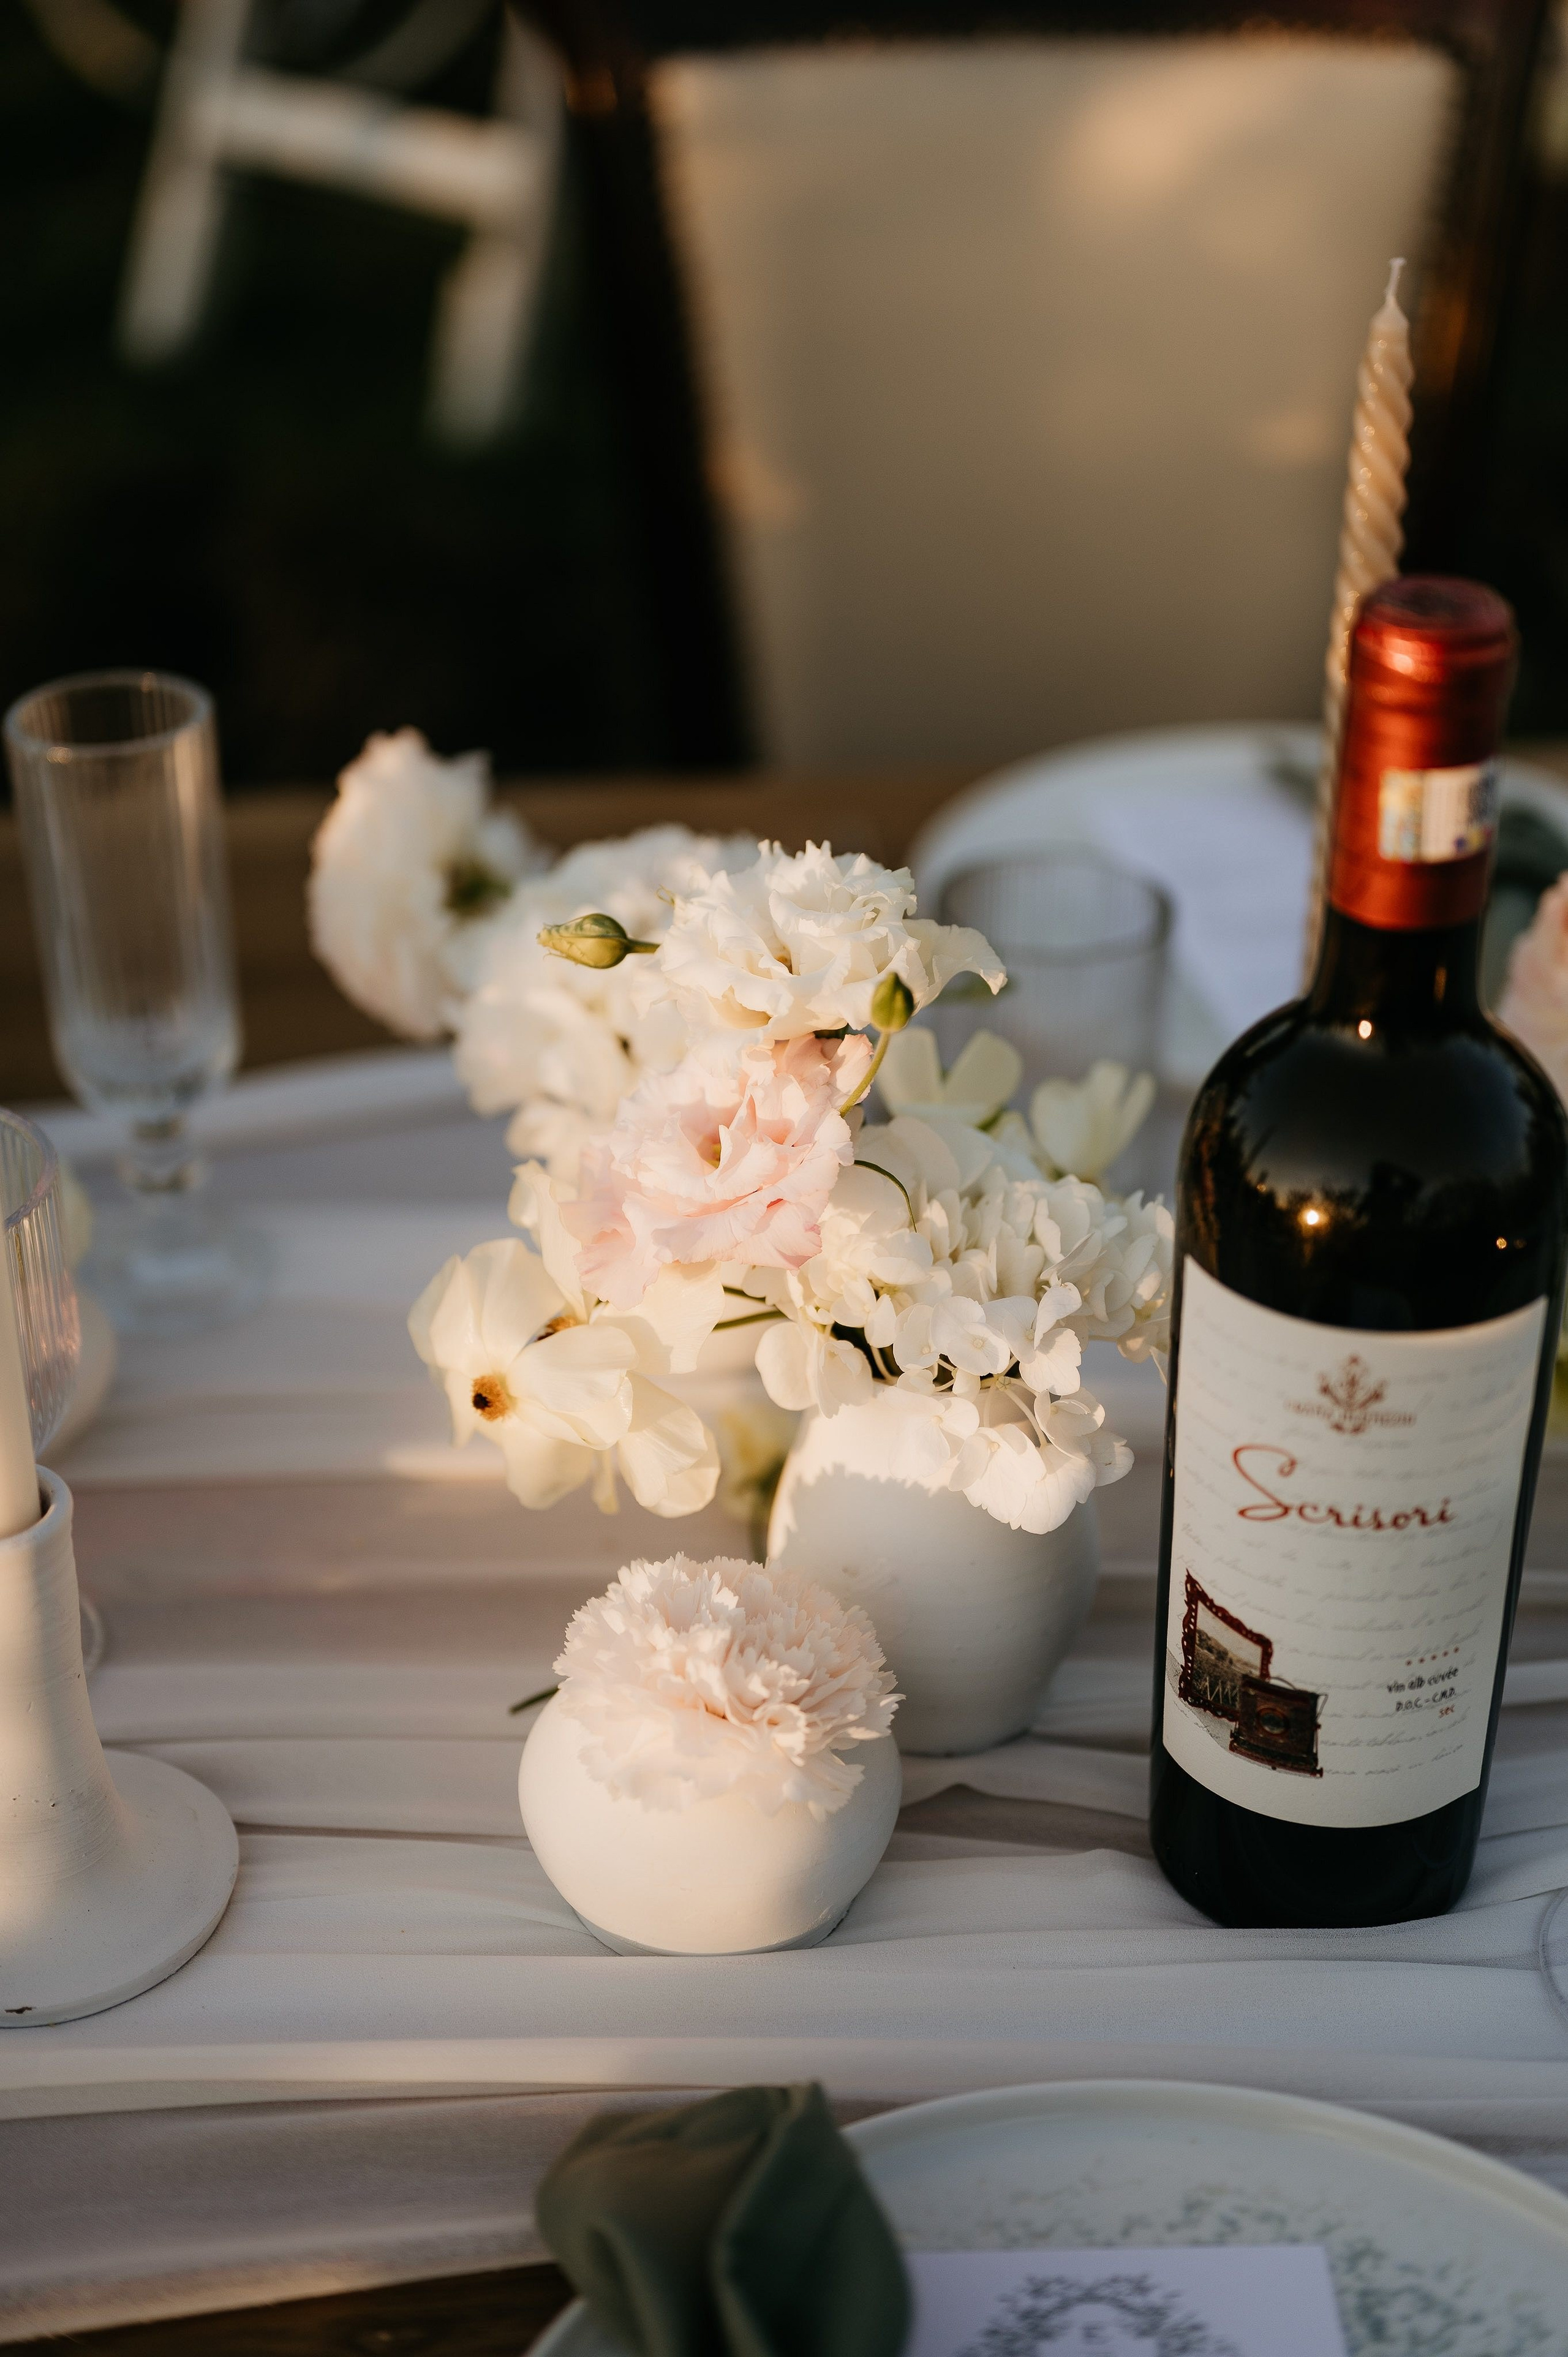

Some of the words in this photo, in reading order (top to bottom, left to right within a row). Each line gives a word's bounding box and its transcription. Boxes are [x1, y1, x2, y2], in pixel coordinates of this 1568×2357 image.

[1232, 1443, 1458, 1530] Scrisori
[1387, 1680, 1406, 1694] vin
[1408, 1675, 1425, 1691] alb
[1439, 1703, 1455, 1718] sec
